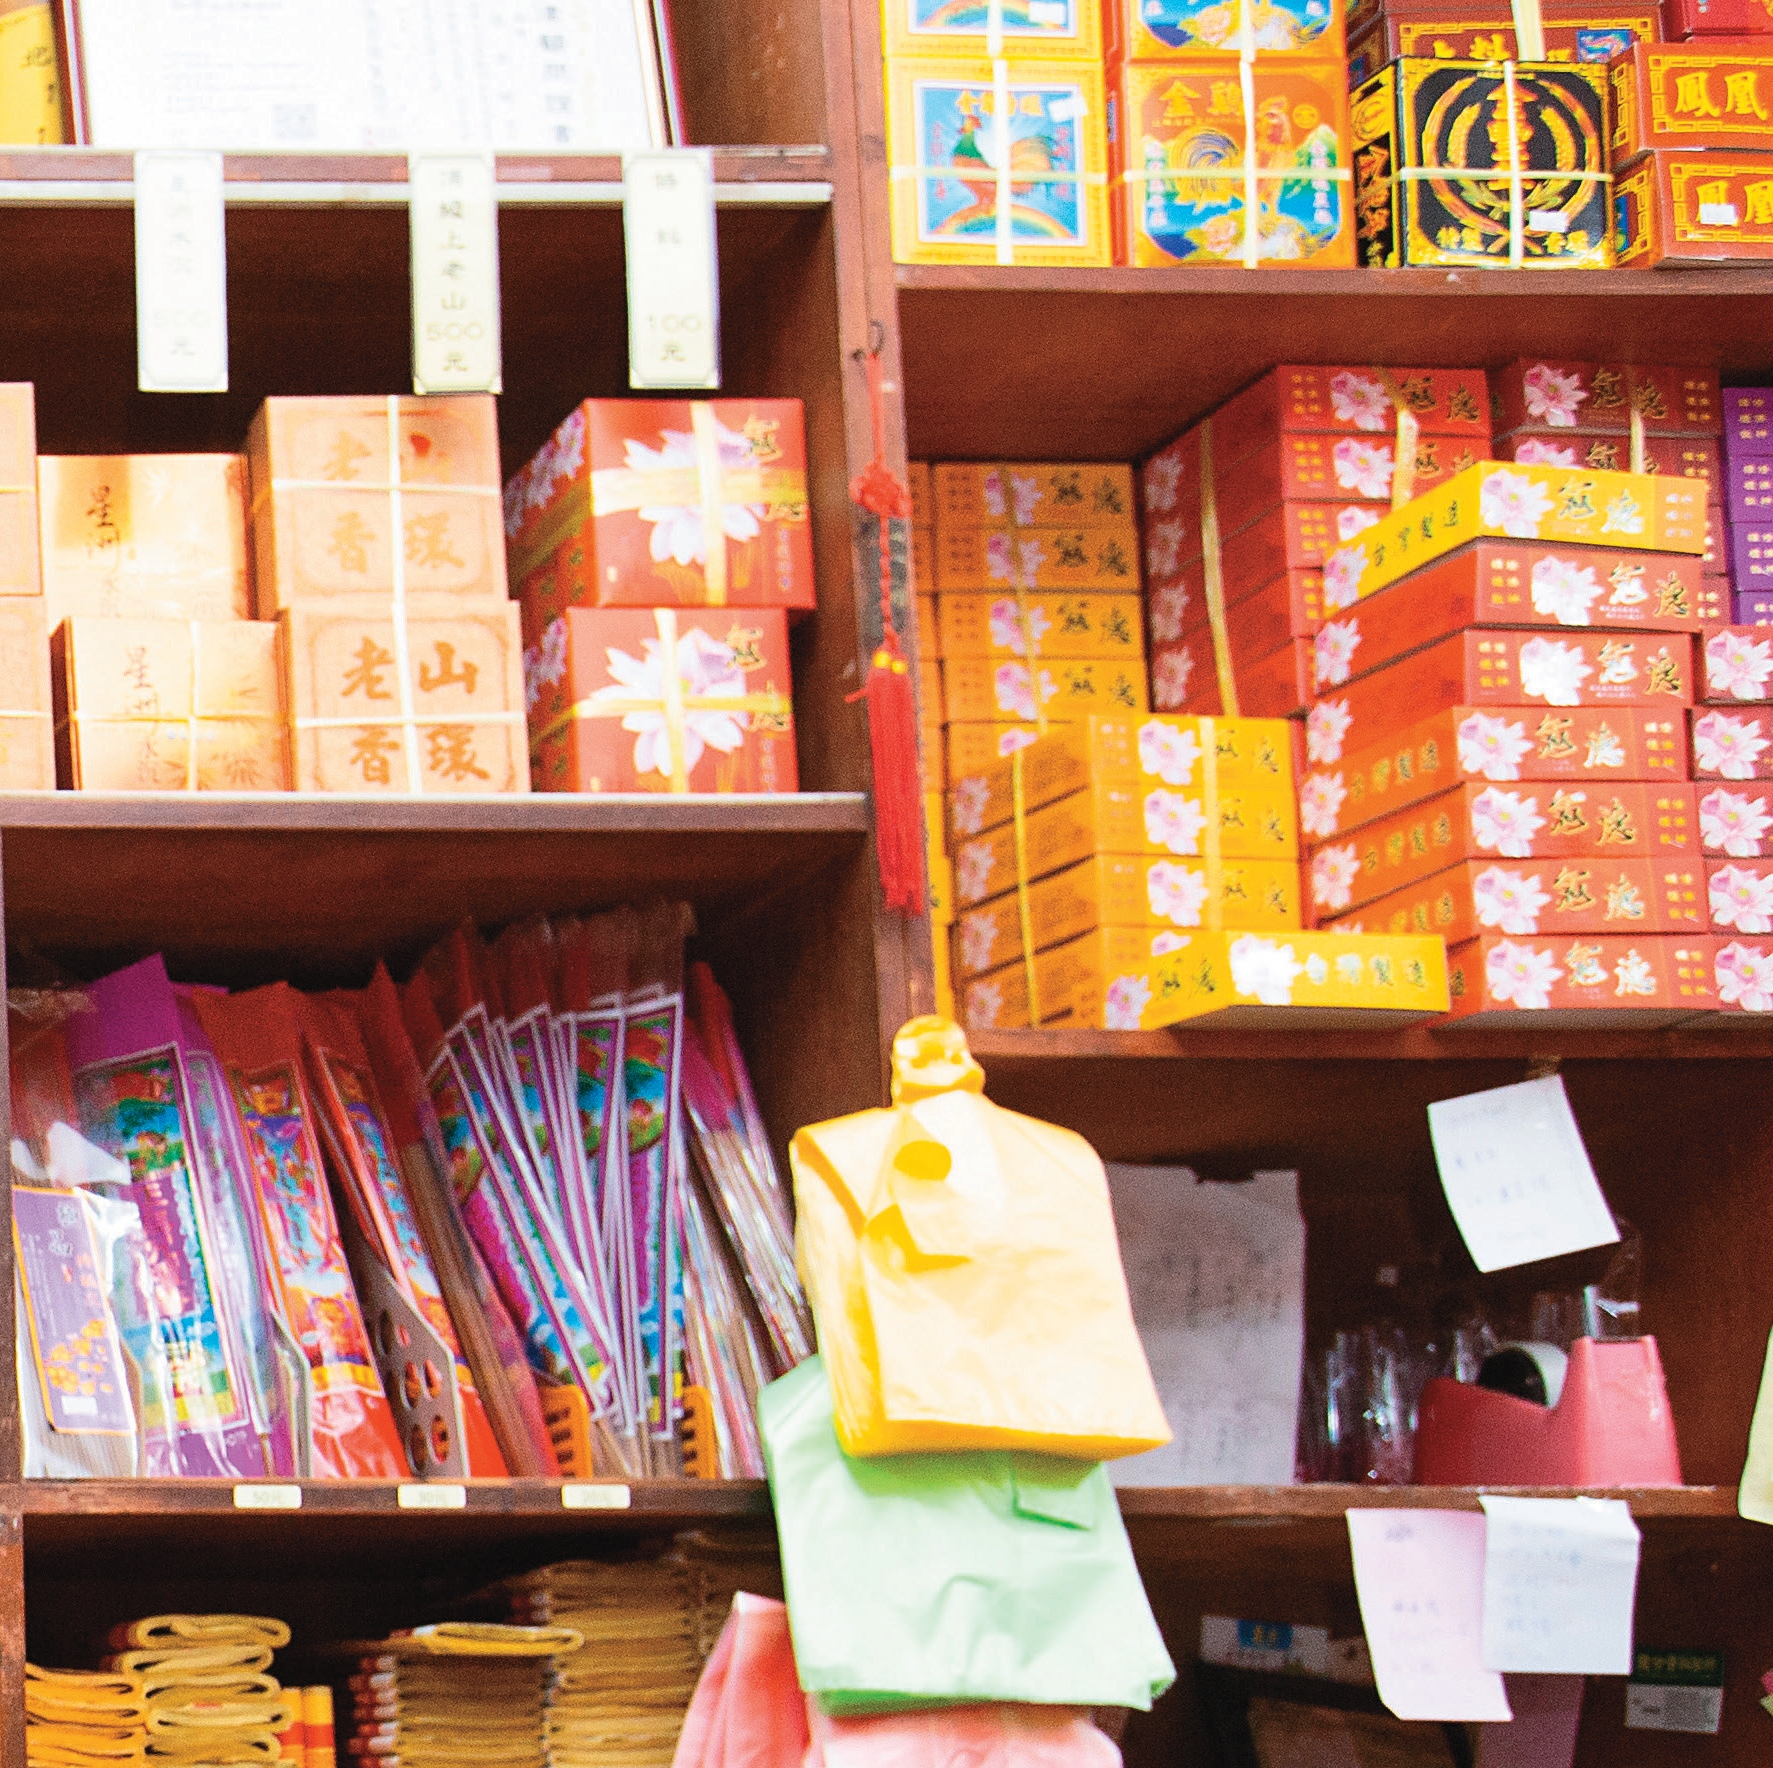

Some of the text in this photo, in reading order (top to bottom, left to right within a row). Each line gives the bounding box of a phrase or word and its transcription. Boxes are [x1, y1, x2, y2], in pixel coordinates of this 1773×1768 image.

[426, 321, 486, 343] 500
[646, 312, 702, 336] 100
[441, 350, 468, 374] 元
[660, 341, 686, 364] 元
[340, 635, 480, 704] 老山
